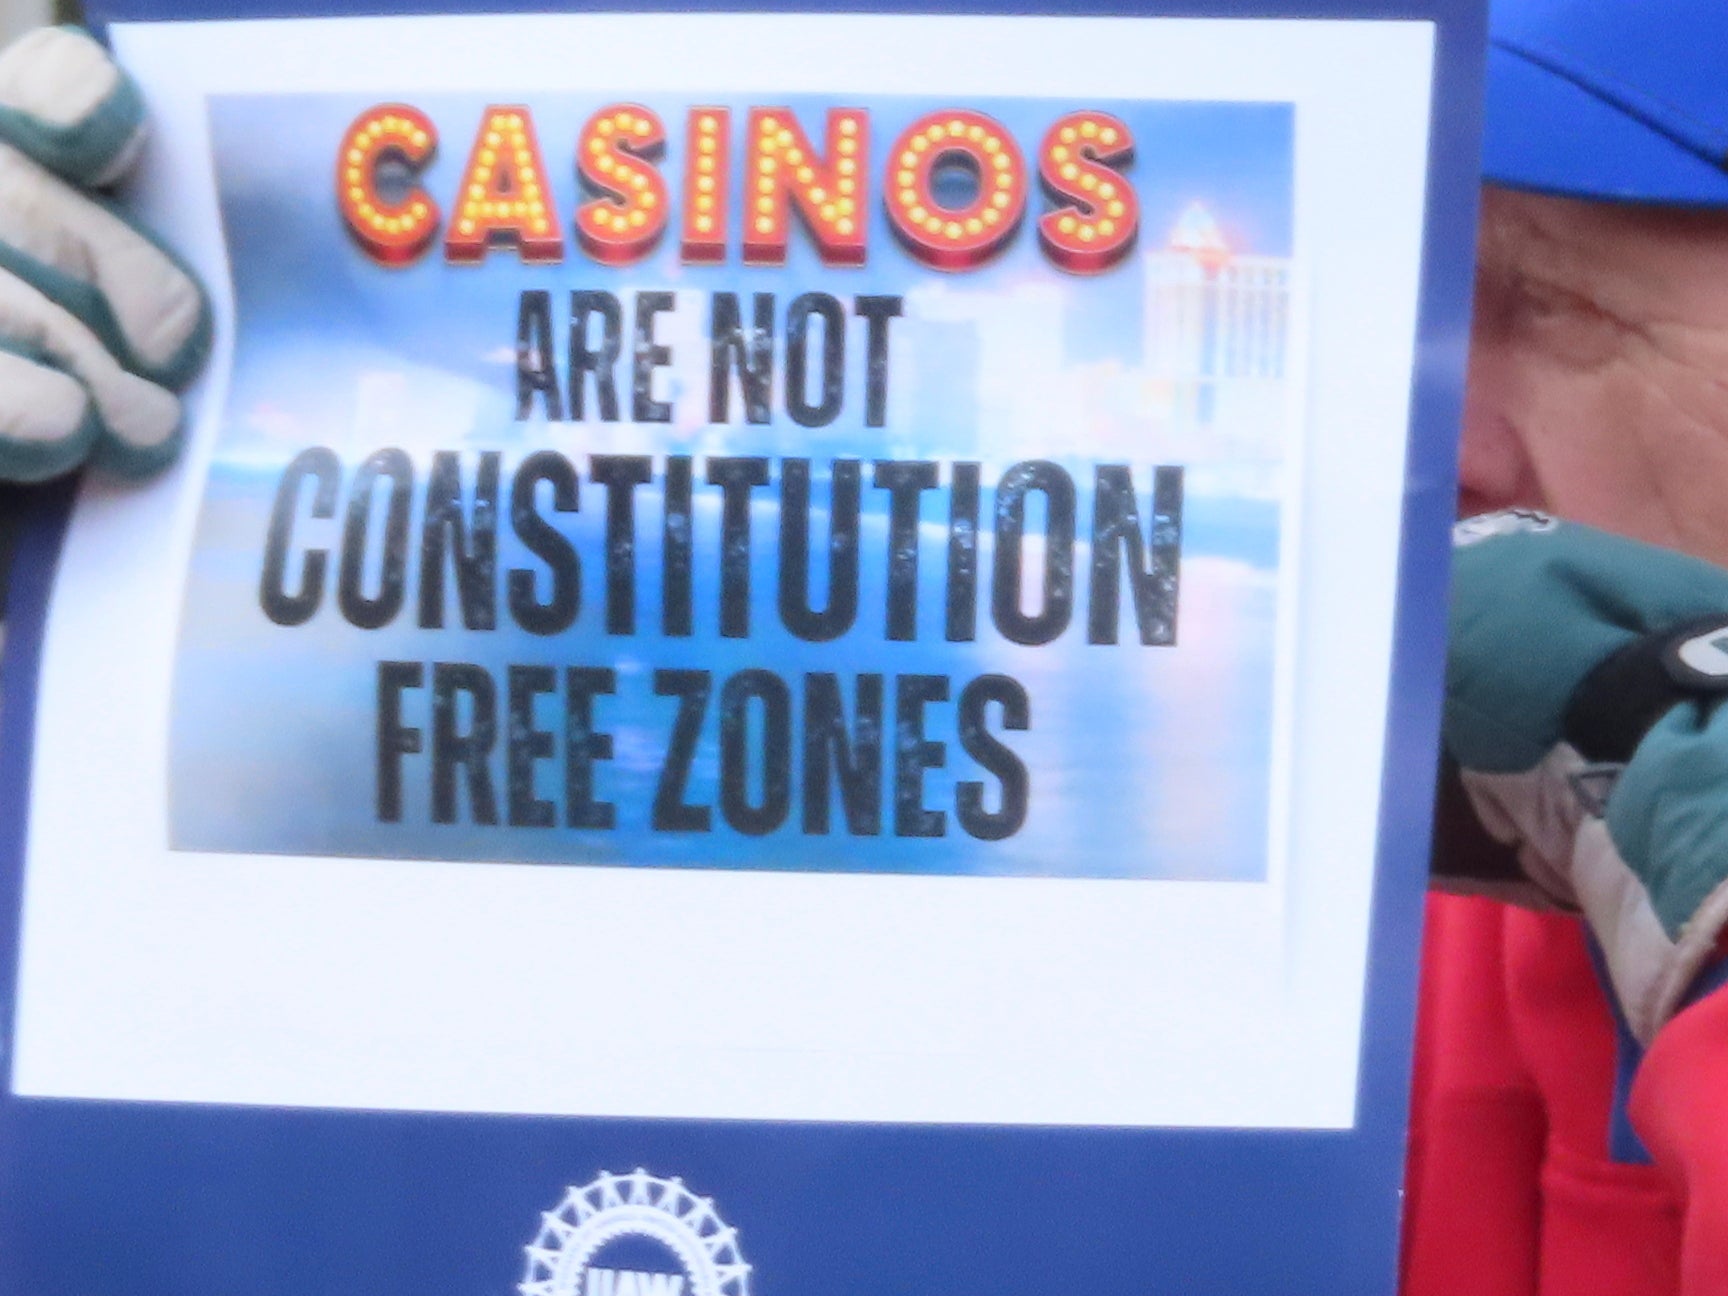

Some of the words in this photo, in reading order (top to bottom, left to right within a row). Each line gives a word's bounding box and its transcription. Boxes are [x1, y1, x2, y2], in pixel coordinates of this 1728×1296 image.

[335, 102, 1141, 276] CASINOS
[514, 290, 676, 424] ARE
[708, 291, 904, 428] NOT
[258, 446, 1186, 647] CONSTITUTION
[375, 661, 617, 831] FREE
[650, 667, 1032, 842] ZONES
